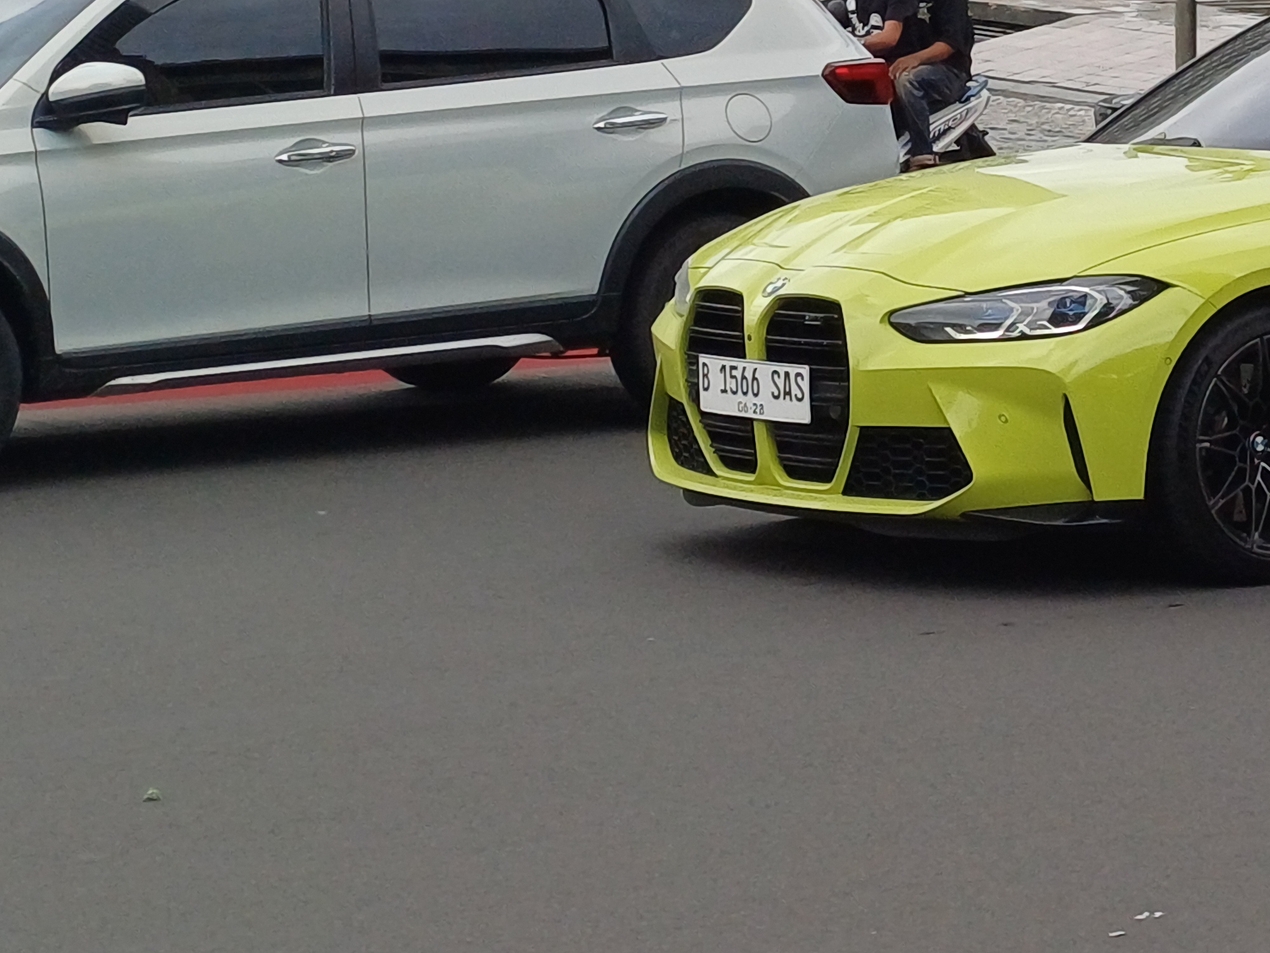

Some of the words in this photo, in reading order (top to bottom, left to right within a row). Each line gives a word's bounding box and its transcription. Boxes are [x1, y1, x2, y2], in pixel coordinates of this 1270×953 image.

[701, 362, 711, 392] B
[720, 364, 761, 398] 1566
[771, 369, 805, 403] SAS
